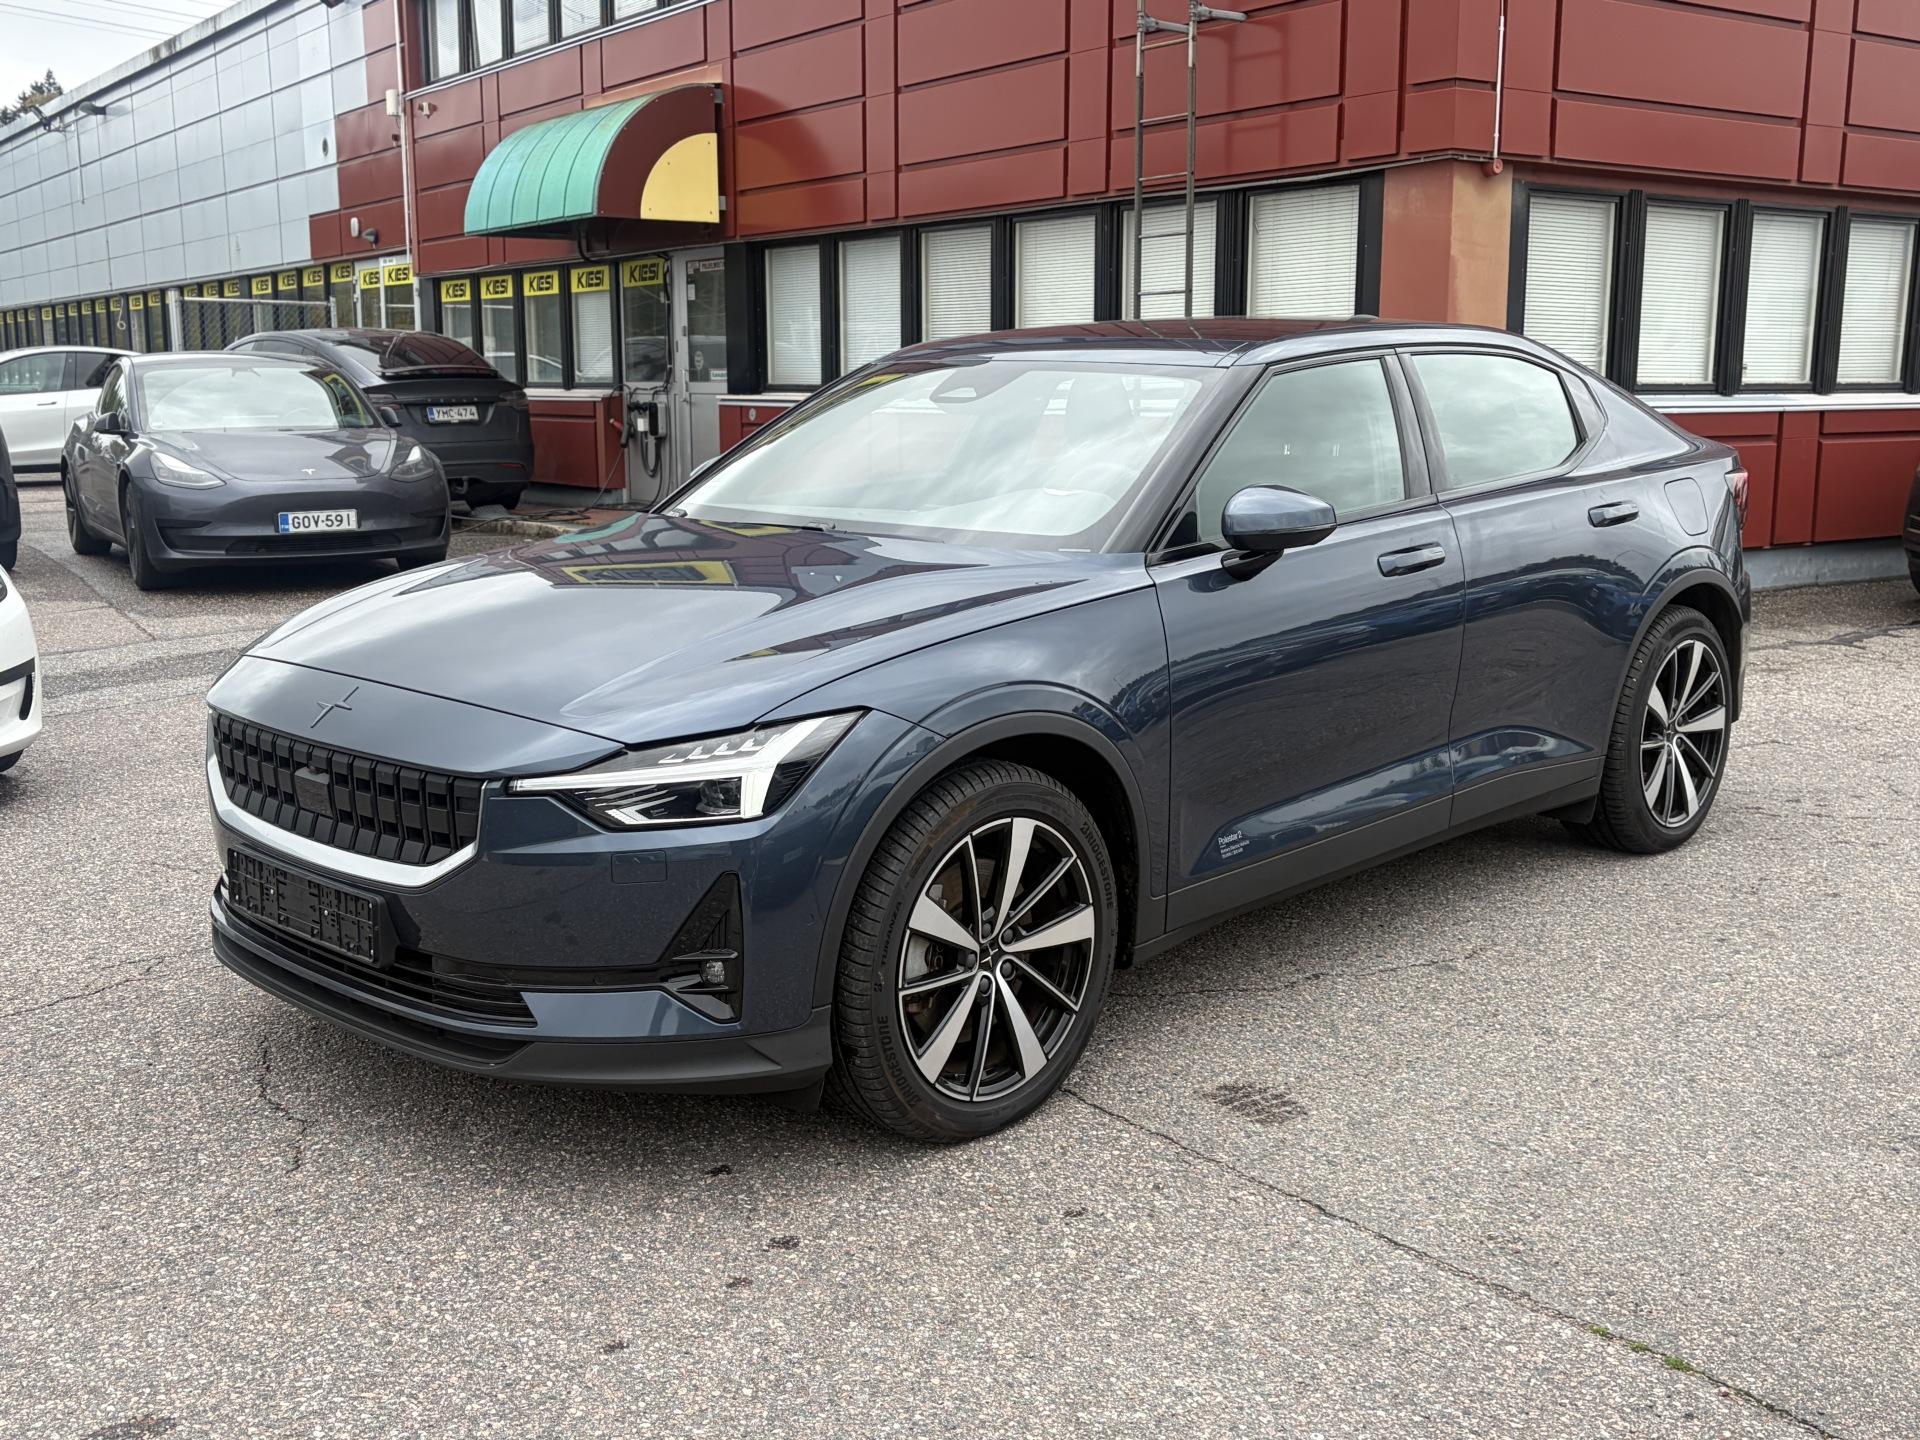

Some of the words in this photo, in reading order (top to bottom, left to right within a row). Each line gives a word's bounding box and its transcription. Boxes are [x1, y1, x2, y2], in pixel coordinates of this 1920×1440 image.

[577, 270, 604, 288] KIESI
[629, 263, 659, 283] KIESI
[446, 282, 466, 298] KIESI
[486, 279, 508, 295] KIESI
[529, 275, 553, 292] KIESI
[436, 408, 475, 418] YMC-474
[292, 513, 351, 529] GOV-591
